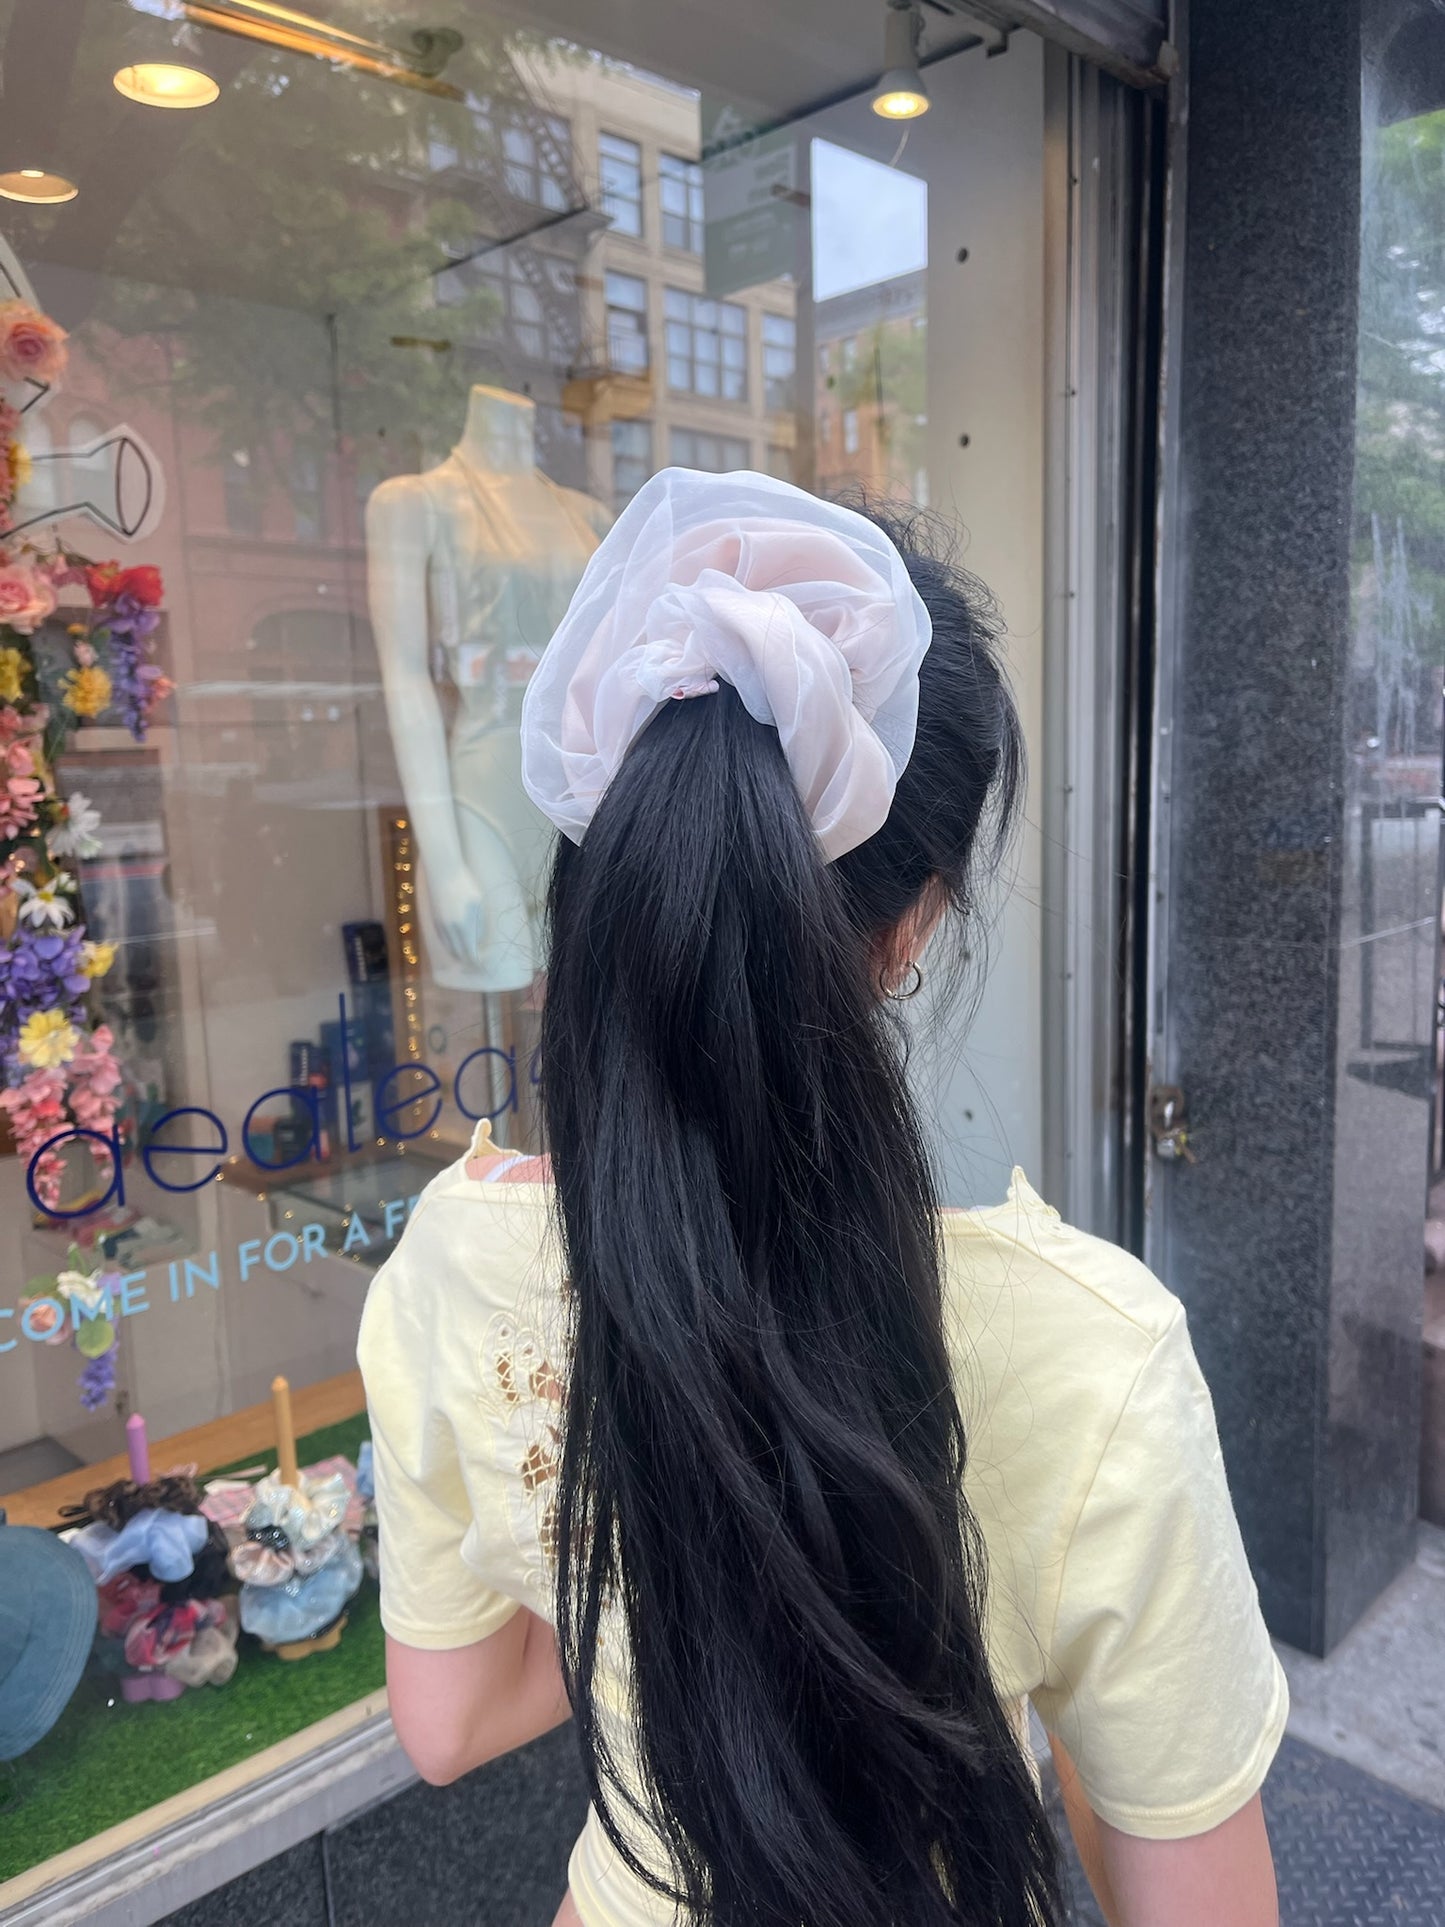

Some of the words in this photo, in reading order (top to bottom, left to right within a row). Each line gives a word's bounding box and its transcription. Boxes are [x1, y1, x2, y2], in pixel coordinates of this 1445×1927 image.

[168, 1251, 219, 1302] IN
[238, 1223, 328, 1281] FOR
[343, 1211, 371, 1253] A
[384, 1194, 421, 1239] F
